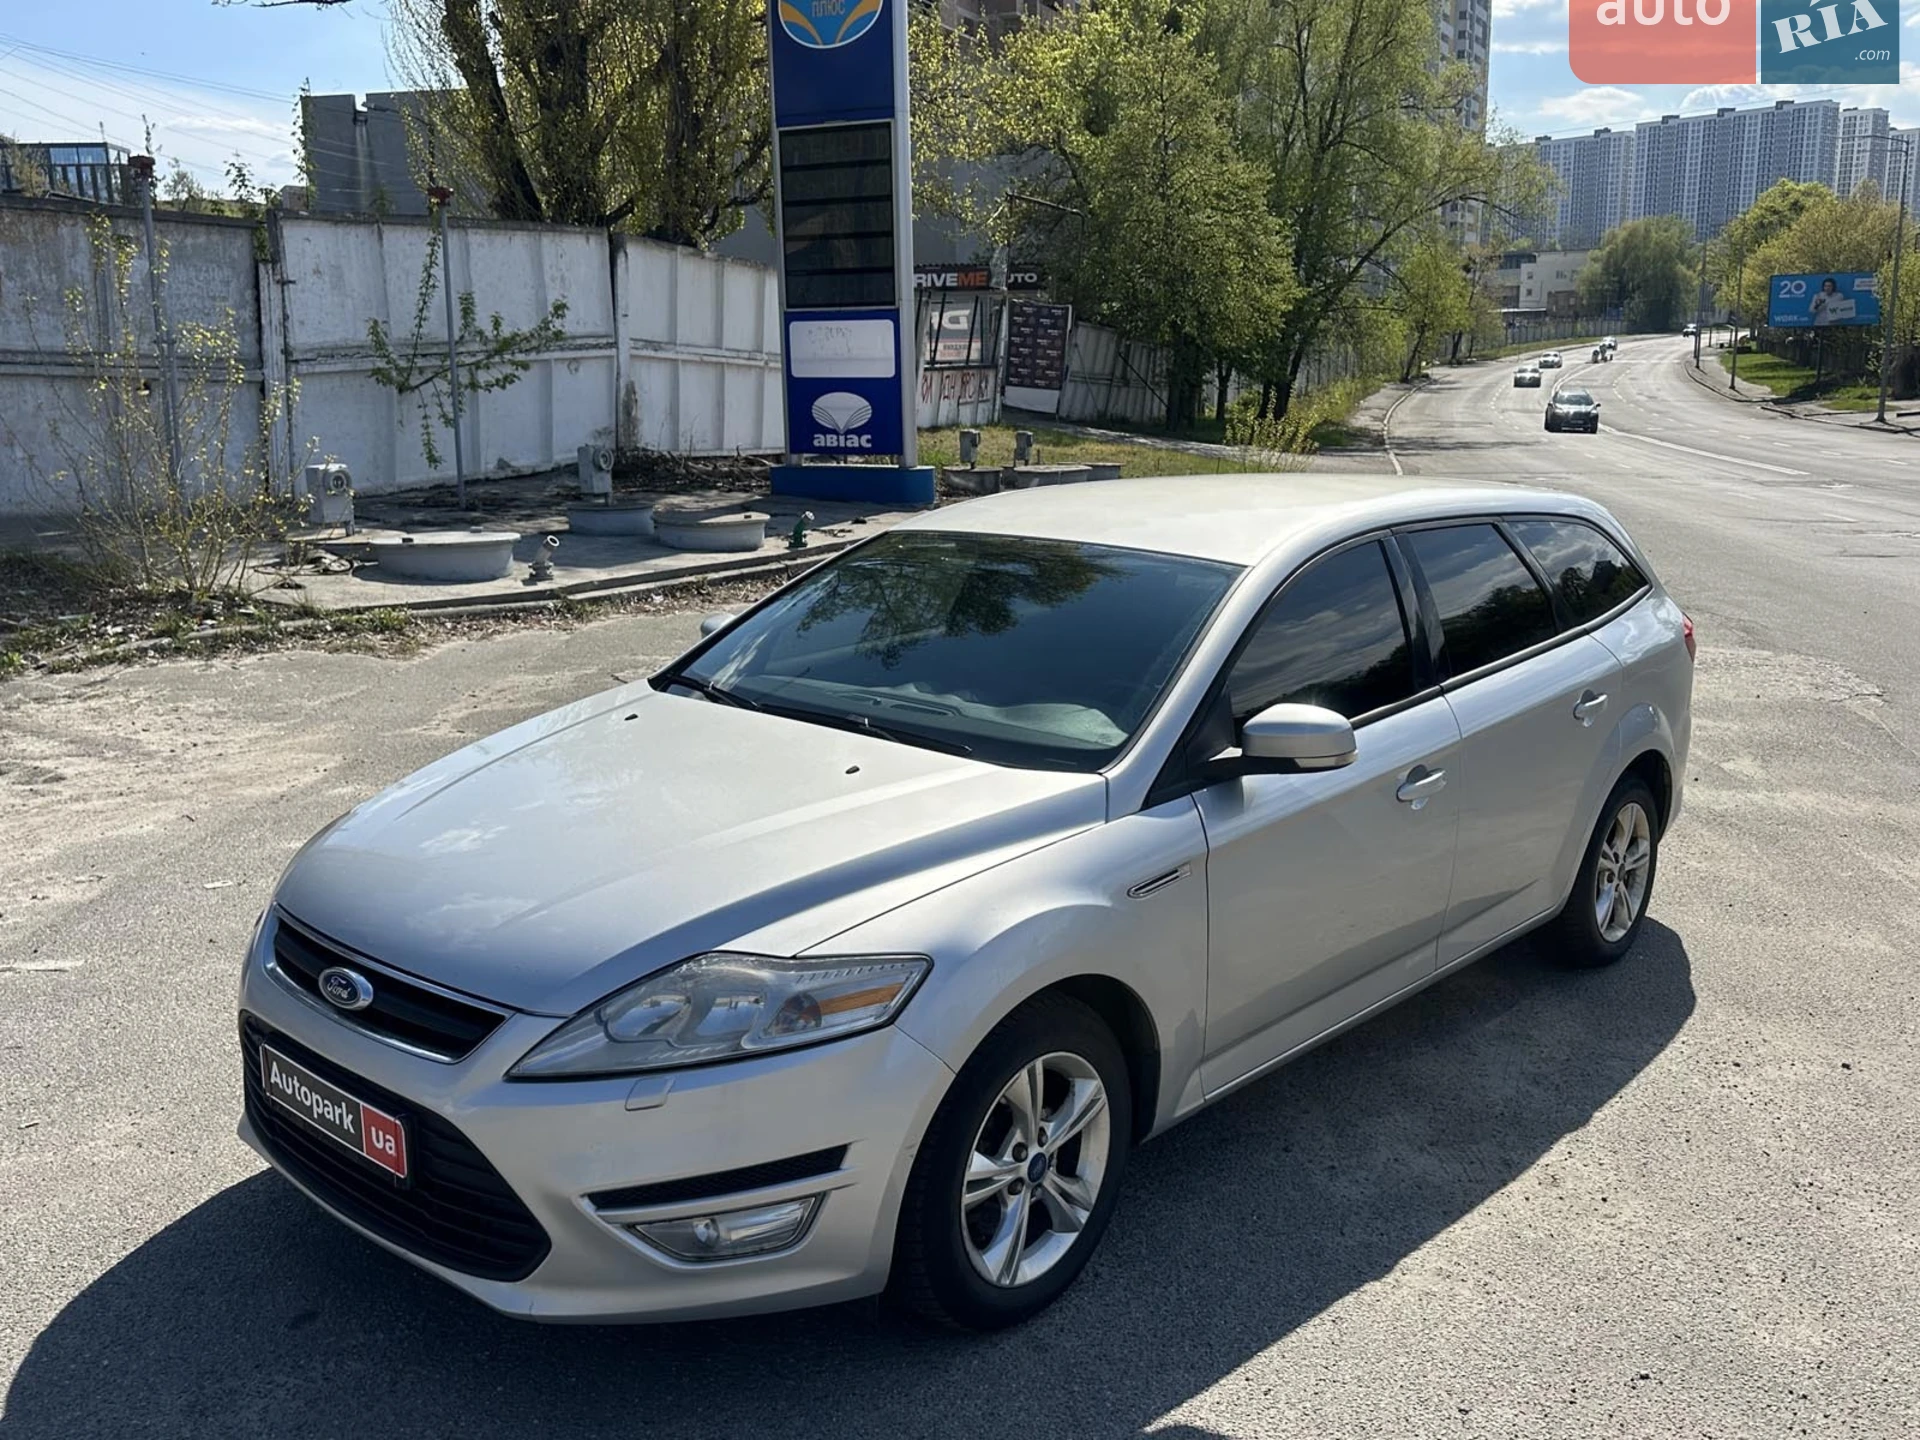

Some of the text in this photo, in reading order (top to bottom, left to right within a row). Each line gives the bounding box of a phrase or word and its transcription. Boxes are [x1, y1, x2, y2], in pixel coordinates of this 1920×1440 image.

[1780, 280, 1806, 294] 20
[327, 975, 352, 999] Ford
[270, 1060, 397, 1157] Autopark ua
